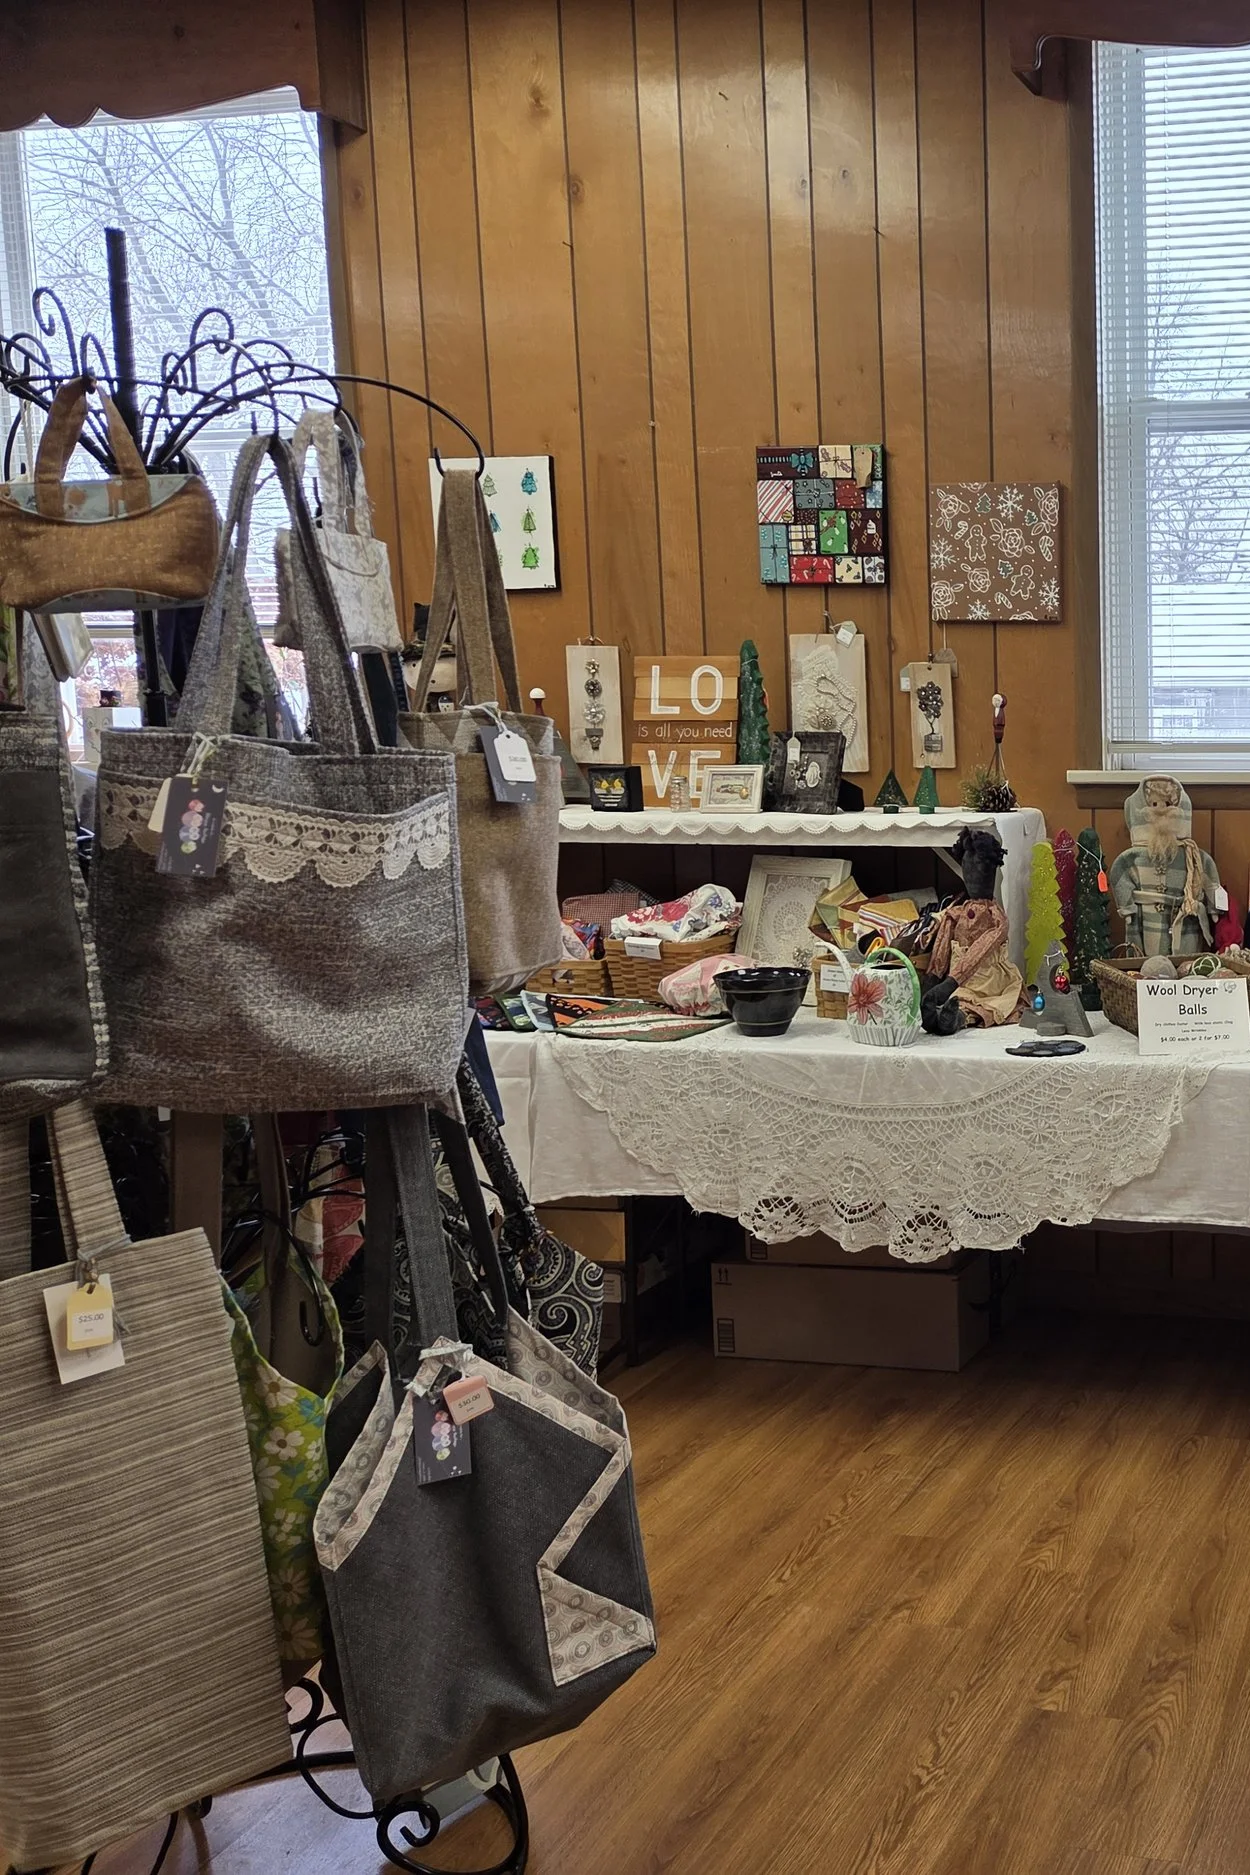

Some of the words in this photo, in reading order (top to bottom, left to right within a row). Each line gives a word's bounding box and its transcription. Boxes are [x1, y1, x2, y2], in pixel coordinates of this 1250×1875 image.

[650, 664, 723, 715] LO
[638, 723, 649, 738] is
[655, 723, 671, 738] all
[676, 728, 699, 743] you
[704, 722, 733, 738] need
[1146, 984, 1177, 996] Wool
[1183, 984, 1218, 998] Dryer
[1178, 1003, 1208, 1015] Balls
[78, 1313, 105, 1323] $25.00
